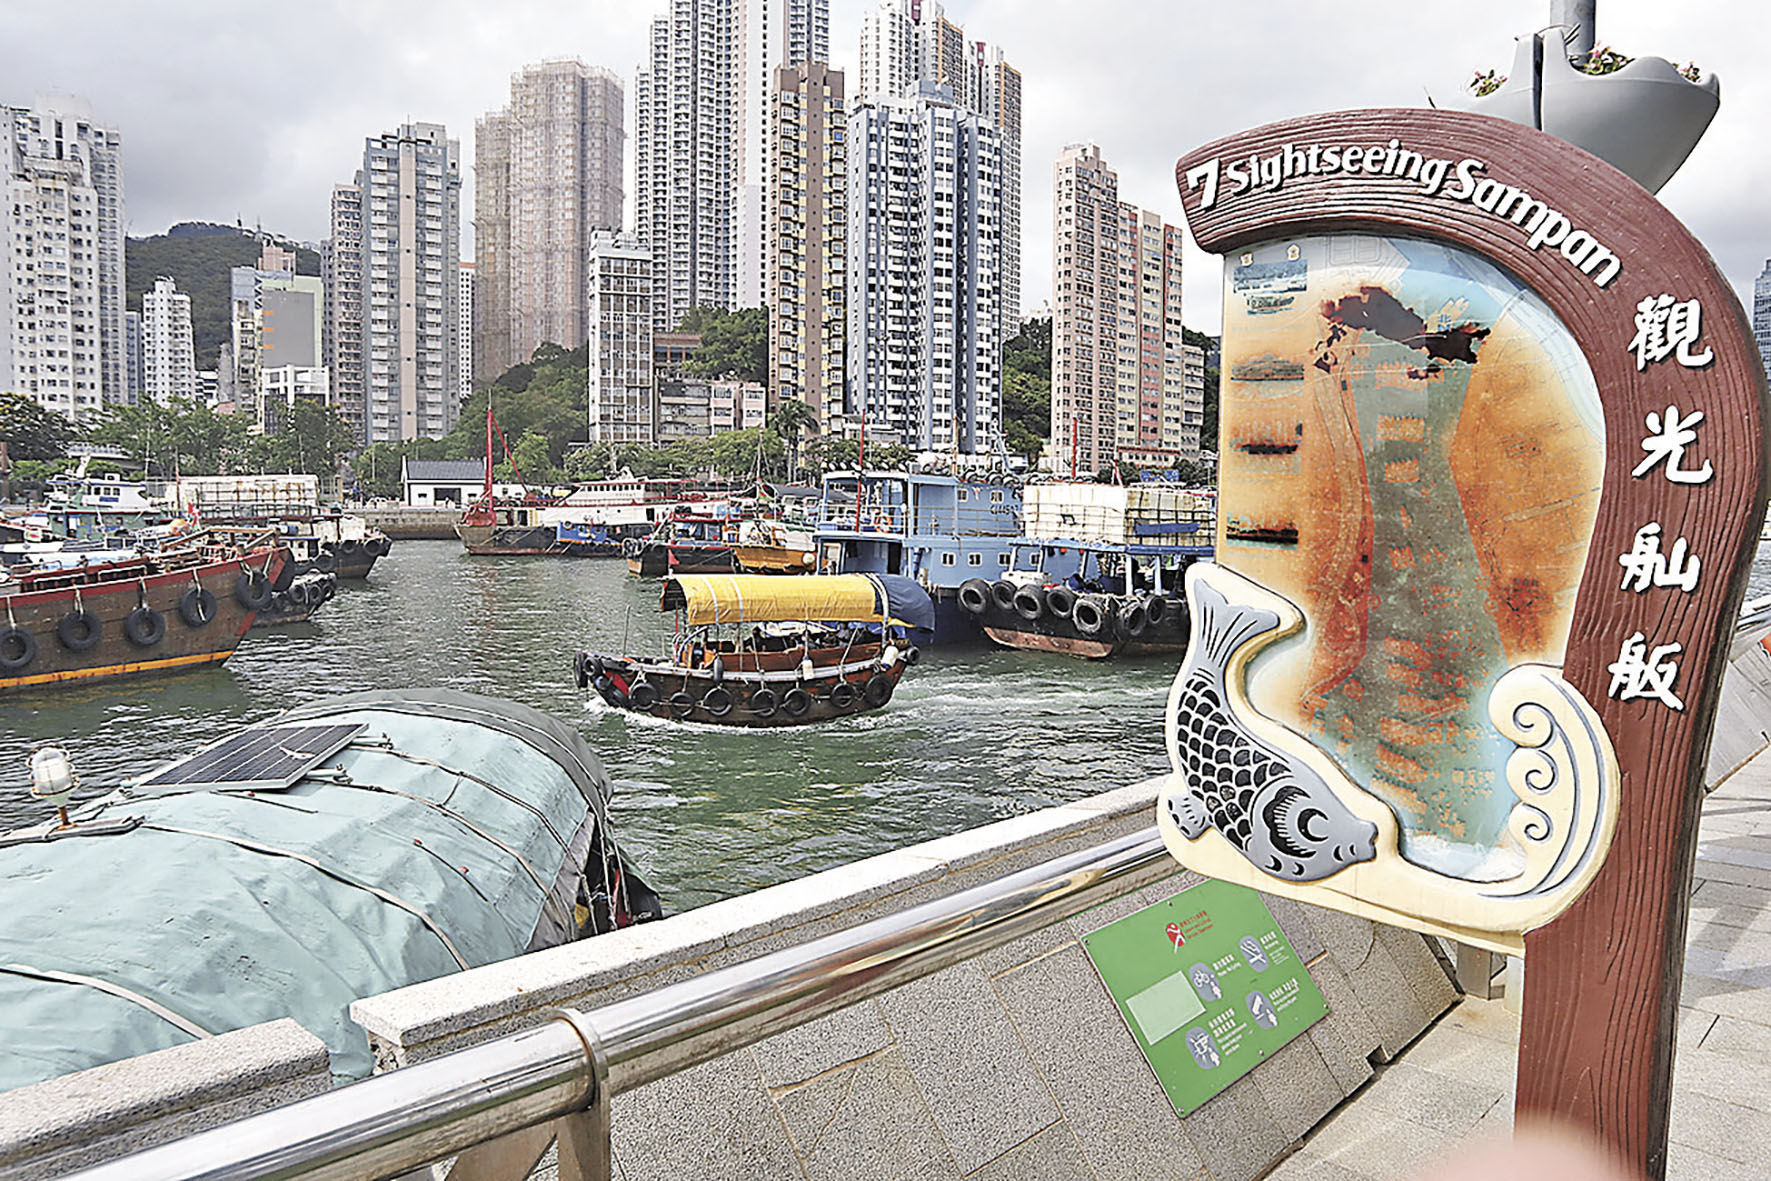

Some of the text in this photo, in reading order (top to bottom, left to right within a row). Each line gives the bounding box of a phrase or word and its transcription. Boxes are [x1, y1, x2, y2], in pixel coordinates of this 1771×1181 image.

[1186, 139, 1622, 287] 7 Sightseeing Sampan
[1608, 294, 1714, 711] 觀光舢舨
